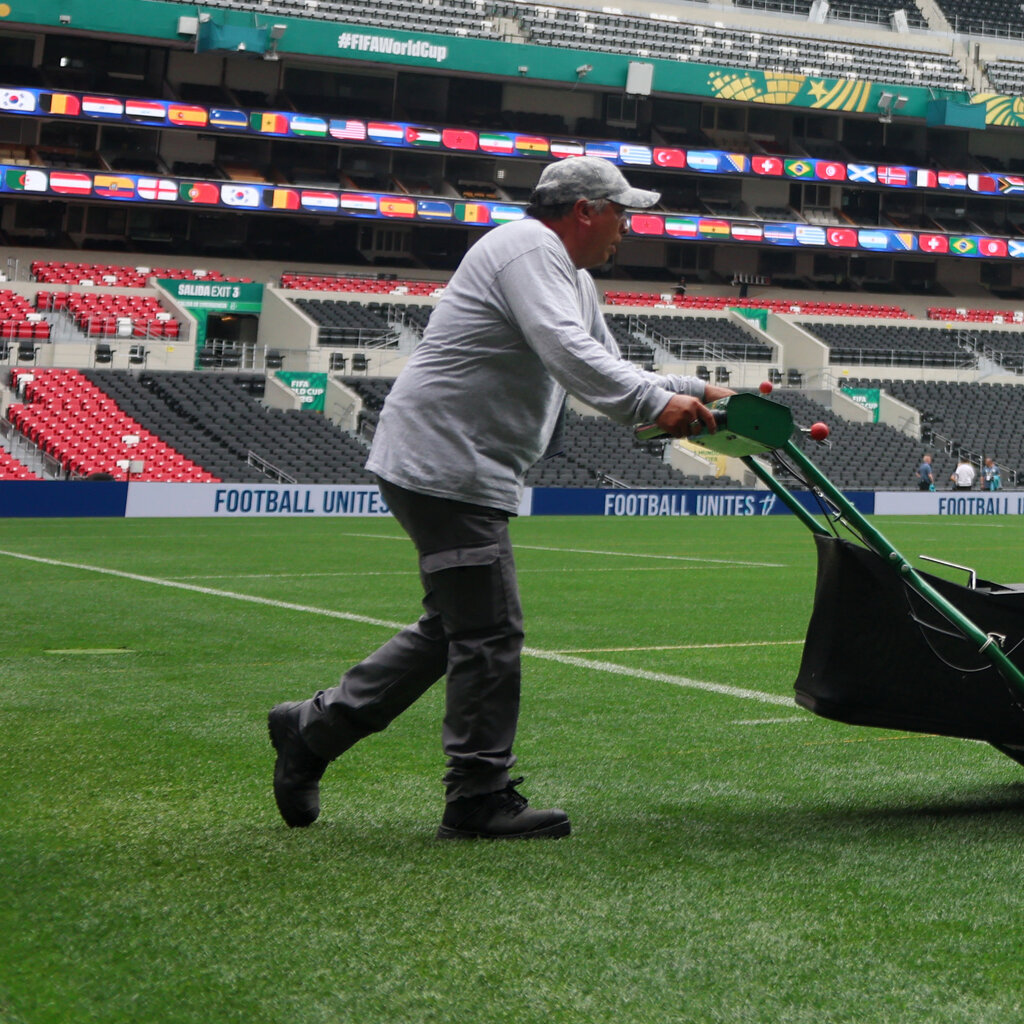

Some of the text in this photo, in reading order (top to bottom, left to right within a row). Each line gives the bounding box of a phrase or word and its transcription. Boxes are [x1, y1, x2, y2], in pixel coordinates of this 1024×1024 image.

[338, 33, 447, 62] #FIFAWorldCup
[178, 284, 240, 298] SALIDA EXIT 3
[291, 380, 310, 388] FIFA
[306, 388, 324, 396] CUP
[214, 489, 391, 513] FOOTBALL UNITES
[604, 494, 755, 516] FOOTBALL UNITES
[939, 497, 1008, 515] FOOTBALL
